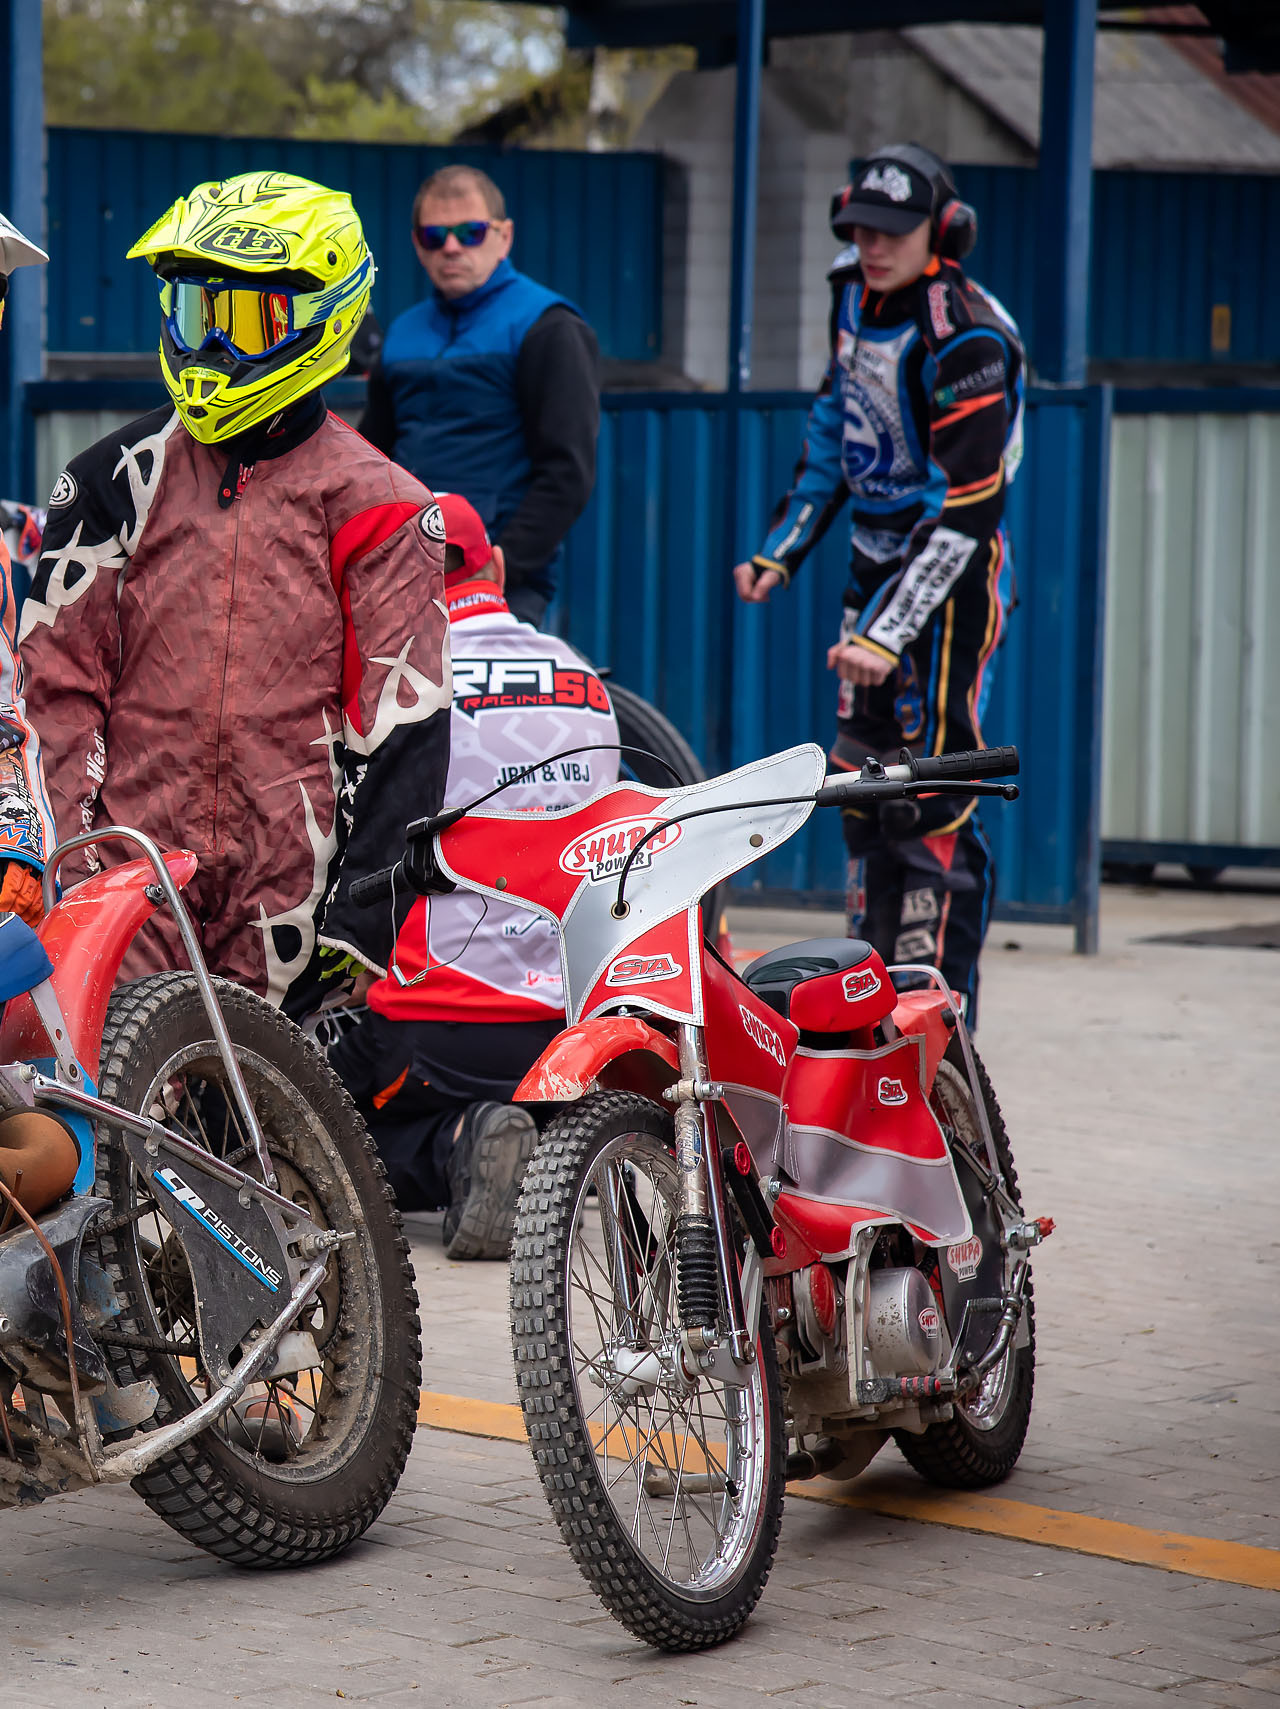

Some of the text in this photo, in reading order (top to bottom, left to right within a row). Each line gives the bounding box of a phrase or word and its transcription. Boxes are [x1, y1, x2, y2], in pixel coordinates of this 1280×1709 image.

[463, 694, 553, 710] RACING
[86, 728, 106, 784] Wear
[497, 762, 591, 786] JBM & VBJ
[573, 821, 668, 868] SHUPA
[595, 851, 645, 876] POWR
[613, 957, 673, 980] STA
[845, 973, 876, 997] STA
[880, 1080, 904, 1099] STA
[202, 1208, 283, 1286] PISTONS
[949, 1241, 980, 1265] SHUPA
